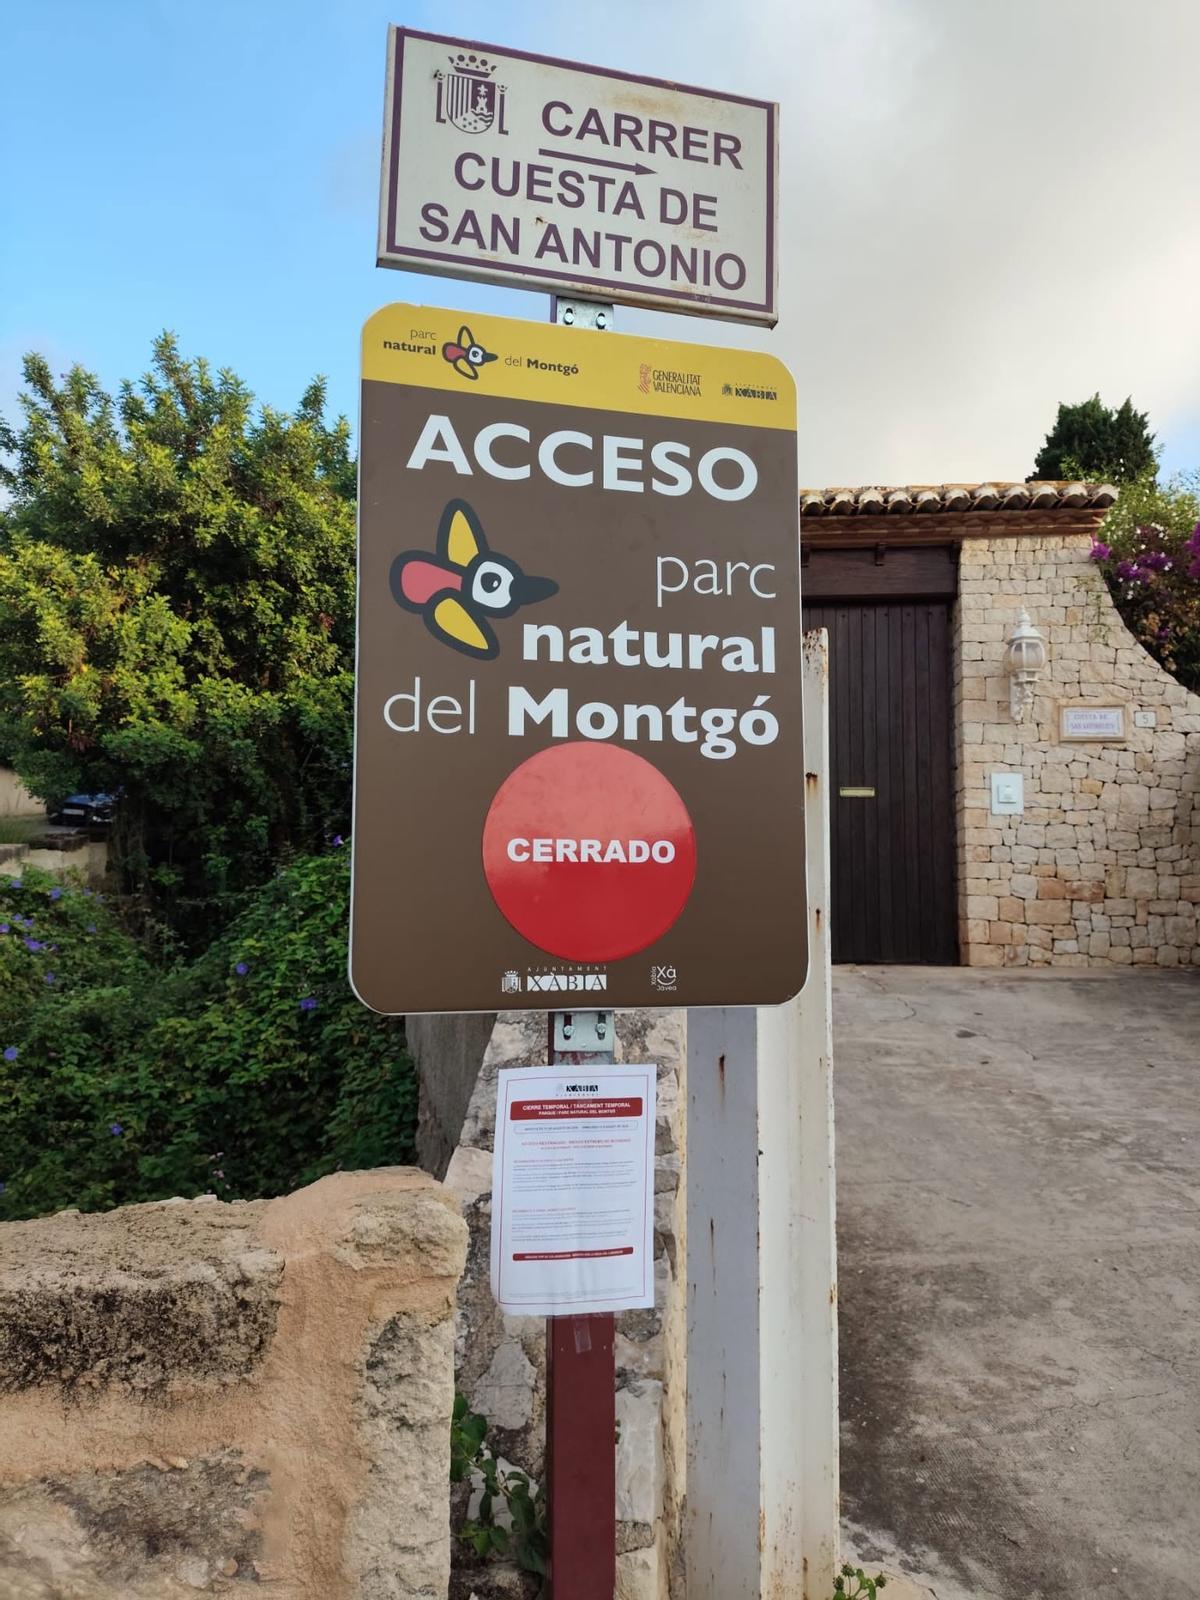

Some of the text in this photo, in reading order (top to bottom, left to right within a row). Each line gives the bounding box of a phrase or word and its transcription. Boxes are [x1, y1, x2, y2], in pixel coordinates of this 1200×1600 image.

[541, 100, 744, 171] CARRER
[454, 152, 719, 233] CUESTA DE
[418, 202, 747, 291] SAN ANTONIO
[383, 340, 437, 356] natural
[410, 328, 437, 341] parc
[504, 354, 580, 376] del Montgó
[652, 369, 702, 386] GENERALITAT
[652, 381, 702, 397] VALENCIANA
[406, 414, 759, 501] ACCESO
[656, 555, 777, 608] parc
[522, 620, 777, 674] natural
[383, 676, 780, 760] del Montgó
[507, 838, 676, 864] CERRADO
